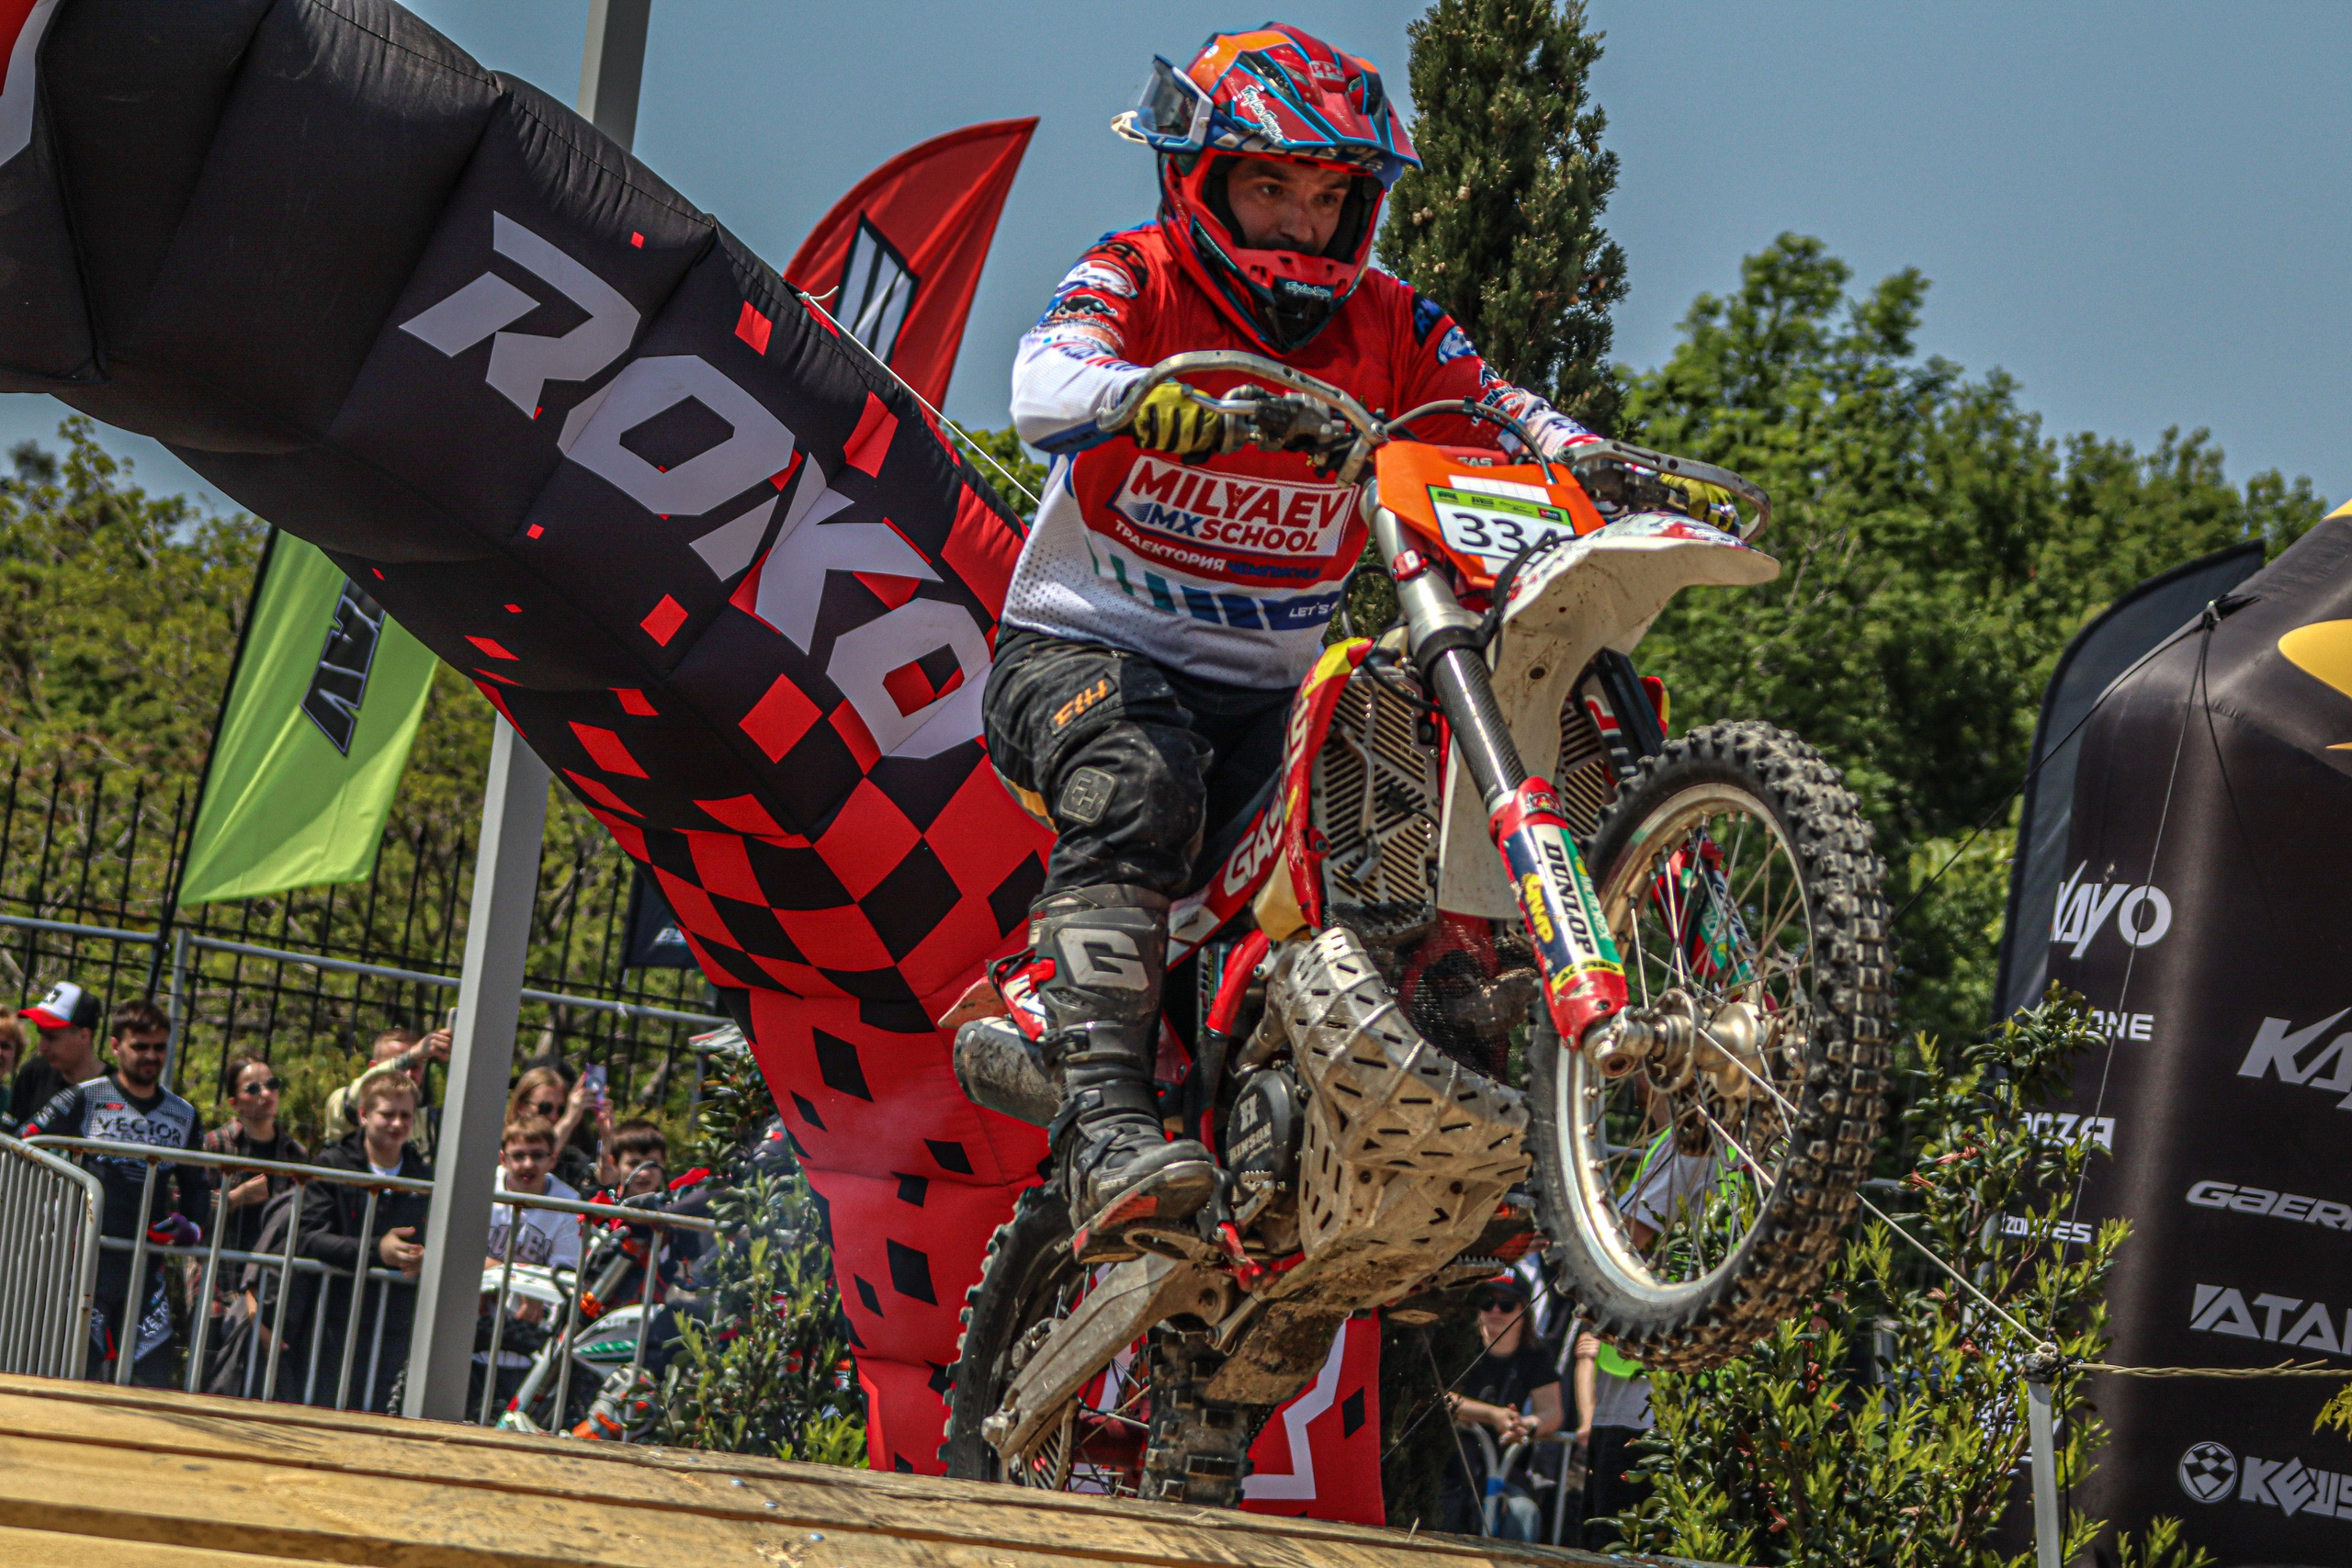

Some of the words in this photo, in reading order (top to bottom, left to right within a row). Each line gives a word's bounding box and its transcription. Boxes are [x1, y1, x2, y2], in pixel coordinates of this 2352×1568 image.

[1130, 460, 1349, 529] MILYAEV
[1115, 519, 1227, 571] ТРАЕКТОРИЯ
[1148, 503, 1204, 536] MX
[1198, 519, 1318, 551] SCHOOL
[1544, 840, 1595, 954] DUNLOP
[97, 1116, 182, 1145] VECTOR
[2189, 1282, 2352, 1356] ATA
